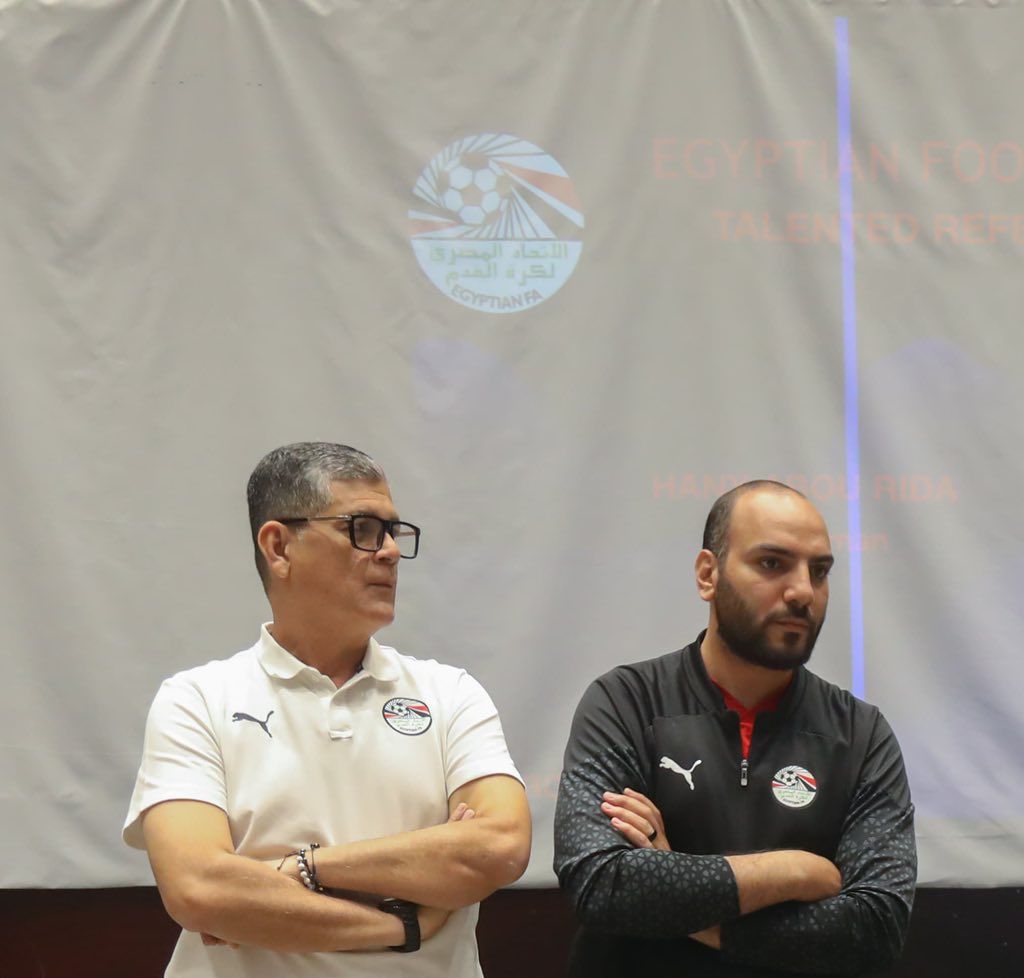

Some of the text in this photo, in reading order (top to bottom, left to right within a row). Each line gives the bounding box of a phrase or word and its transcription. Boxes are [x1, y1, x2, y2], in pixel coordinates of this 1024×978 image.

[651, 137, 899, 182] EGYPTIAN
[711, 210, 920, 243] TALENTED
[450, 284, 545, 309] EGYPTIAN FA
[874, 473, 958, 503] RIDA
